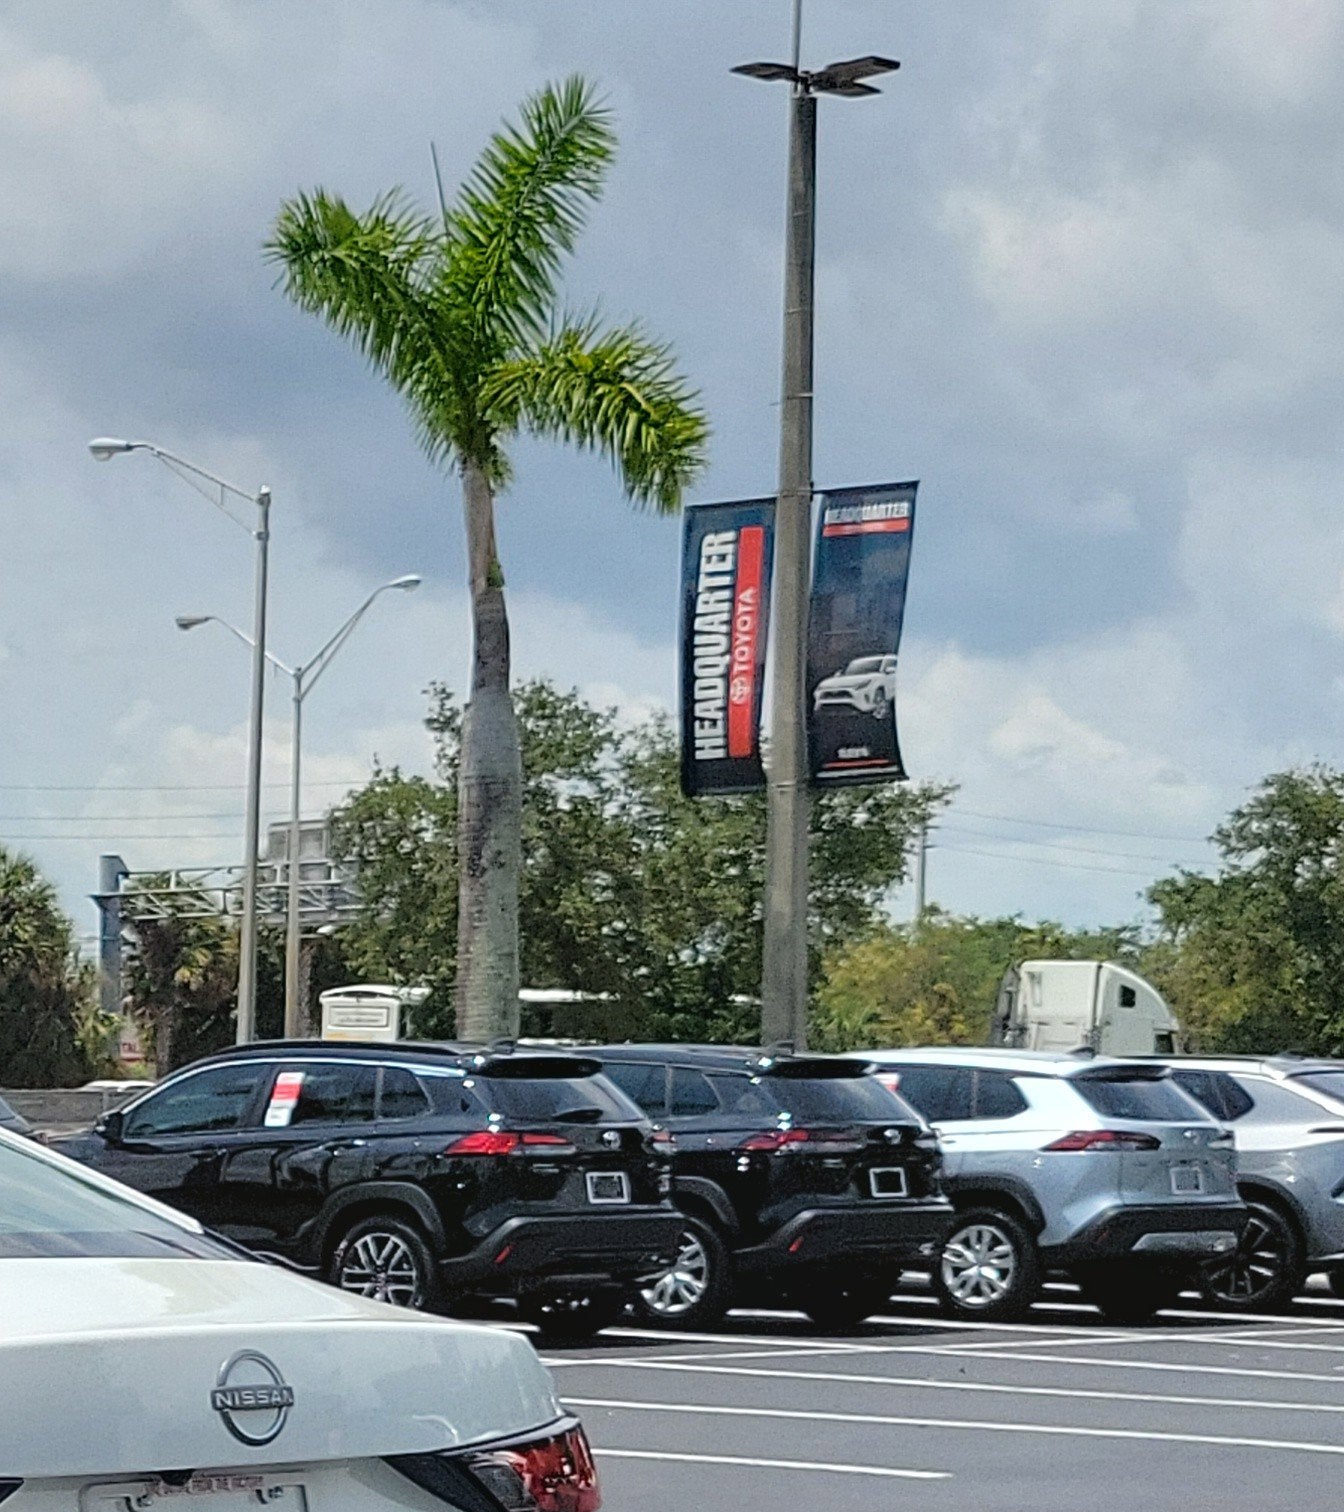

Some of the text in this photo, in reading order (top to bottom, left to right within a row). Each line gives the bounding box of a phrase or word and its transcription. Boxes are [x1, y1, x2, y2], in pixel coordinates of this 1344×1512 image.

[694, 529, 736, 760] HEADQUARTER
[734, 586, 759, 673] TOYOTA
[214, 1388, 293, 1408] NISSAN
